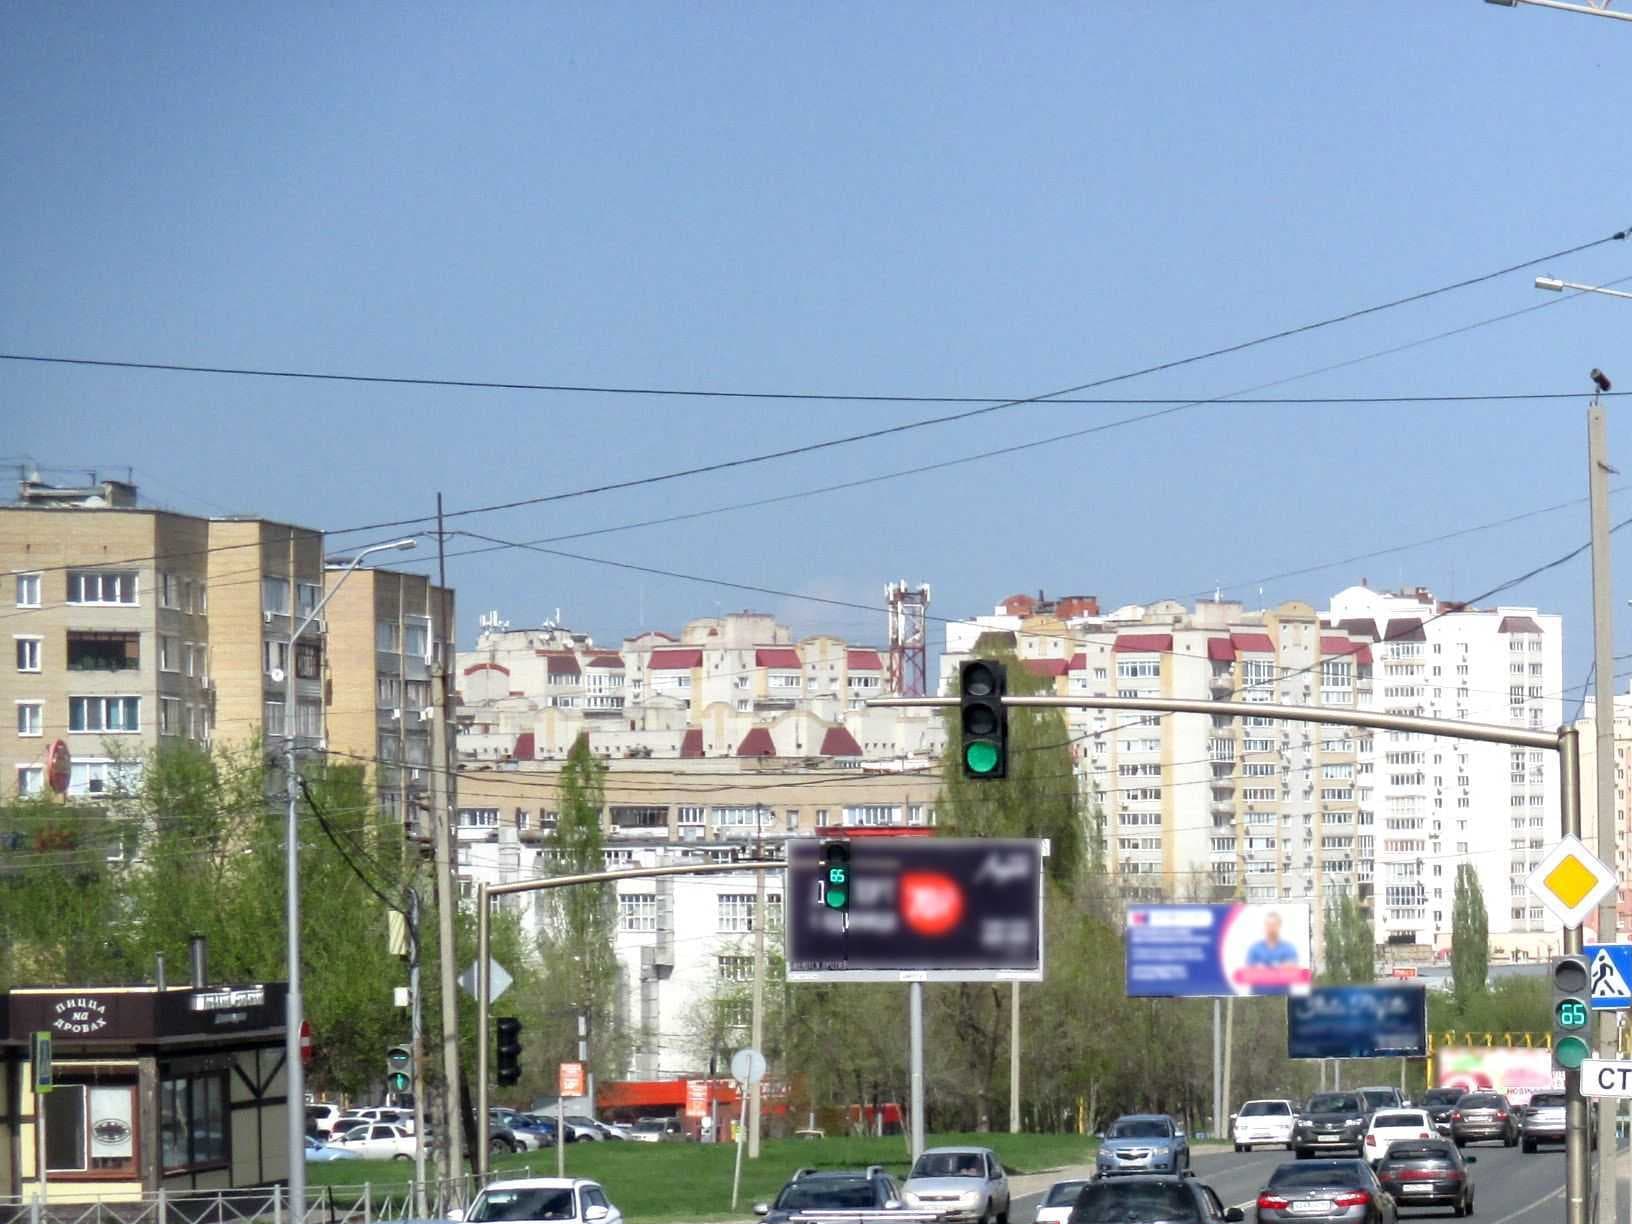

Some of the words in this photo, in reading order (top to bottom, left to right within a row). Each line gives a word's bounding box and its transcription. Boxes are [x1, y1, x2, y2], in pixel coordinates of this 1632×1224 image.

[830, 869, 845, 882] 65
[55, 997, 107, 1014] ПИЦЦА
[72, 1011, 89, 1021] на
[1561, 1004, 1585, 1025] 65
[52, 1018, 108, 1033] ДРОВАХ
